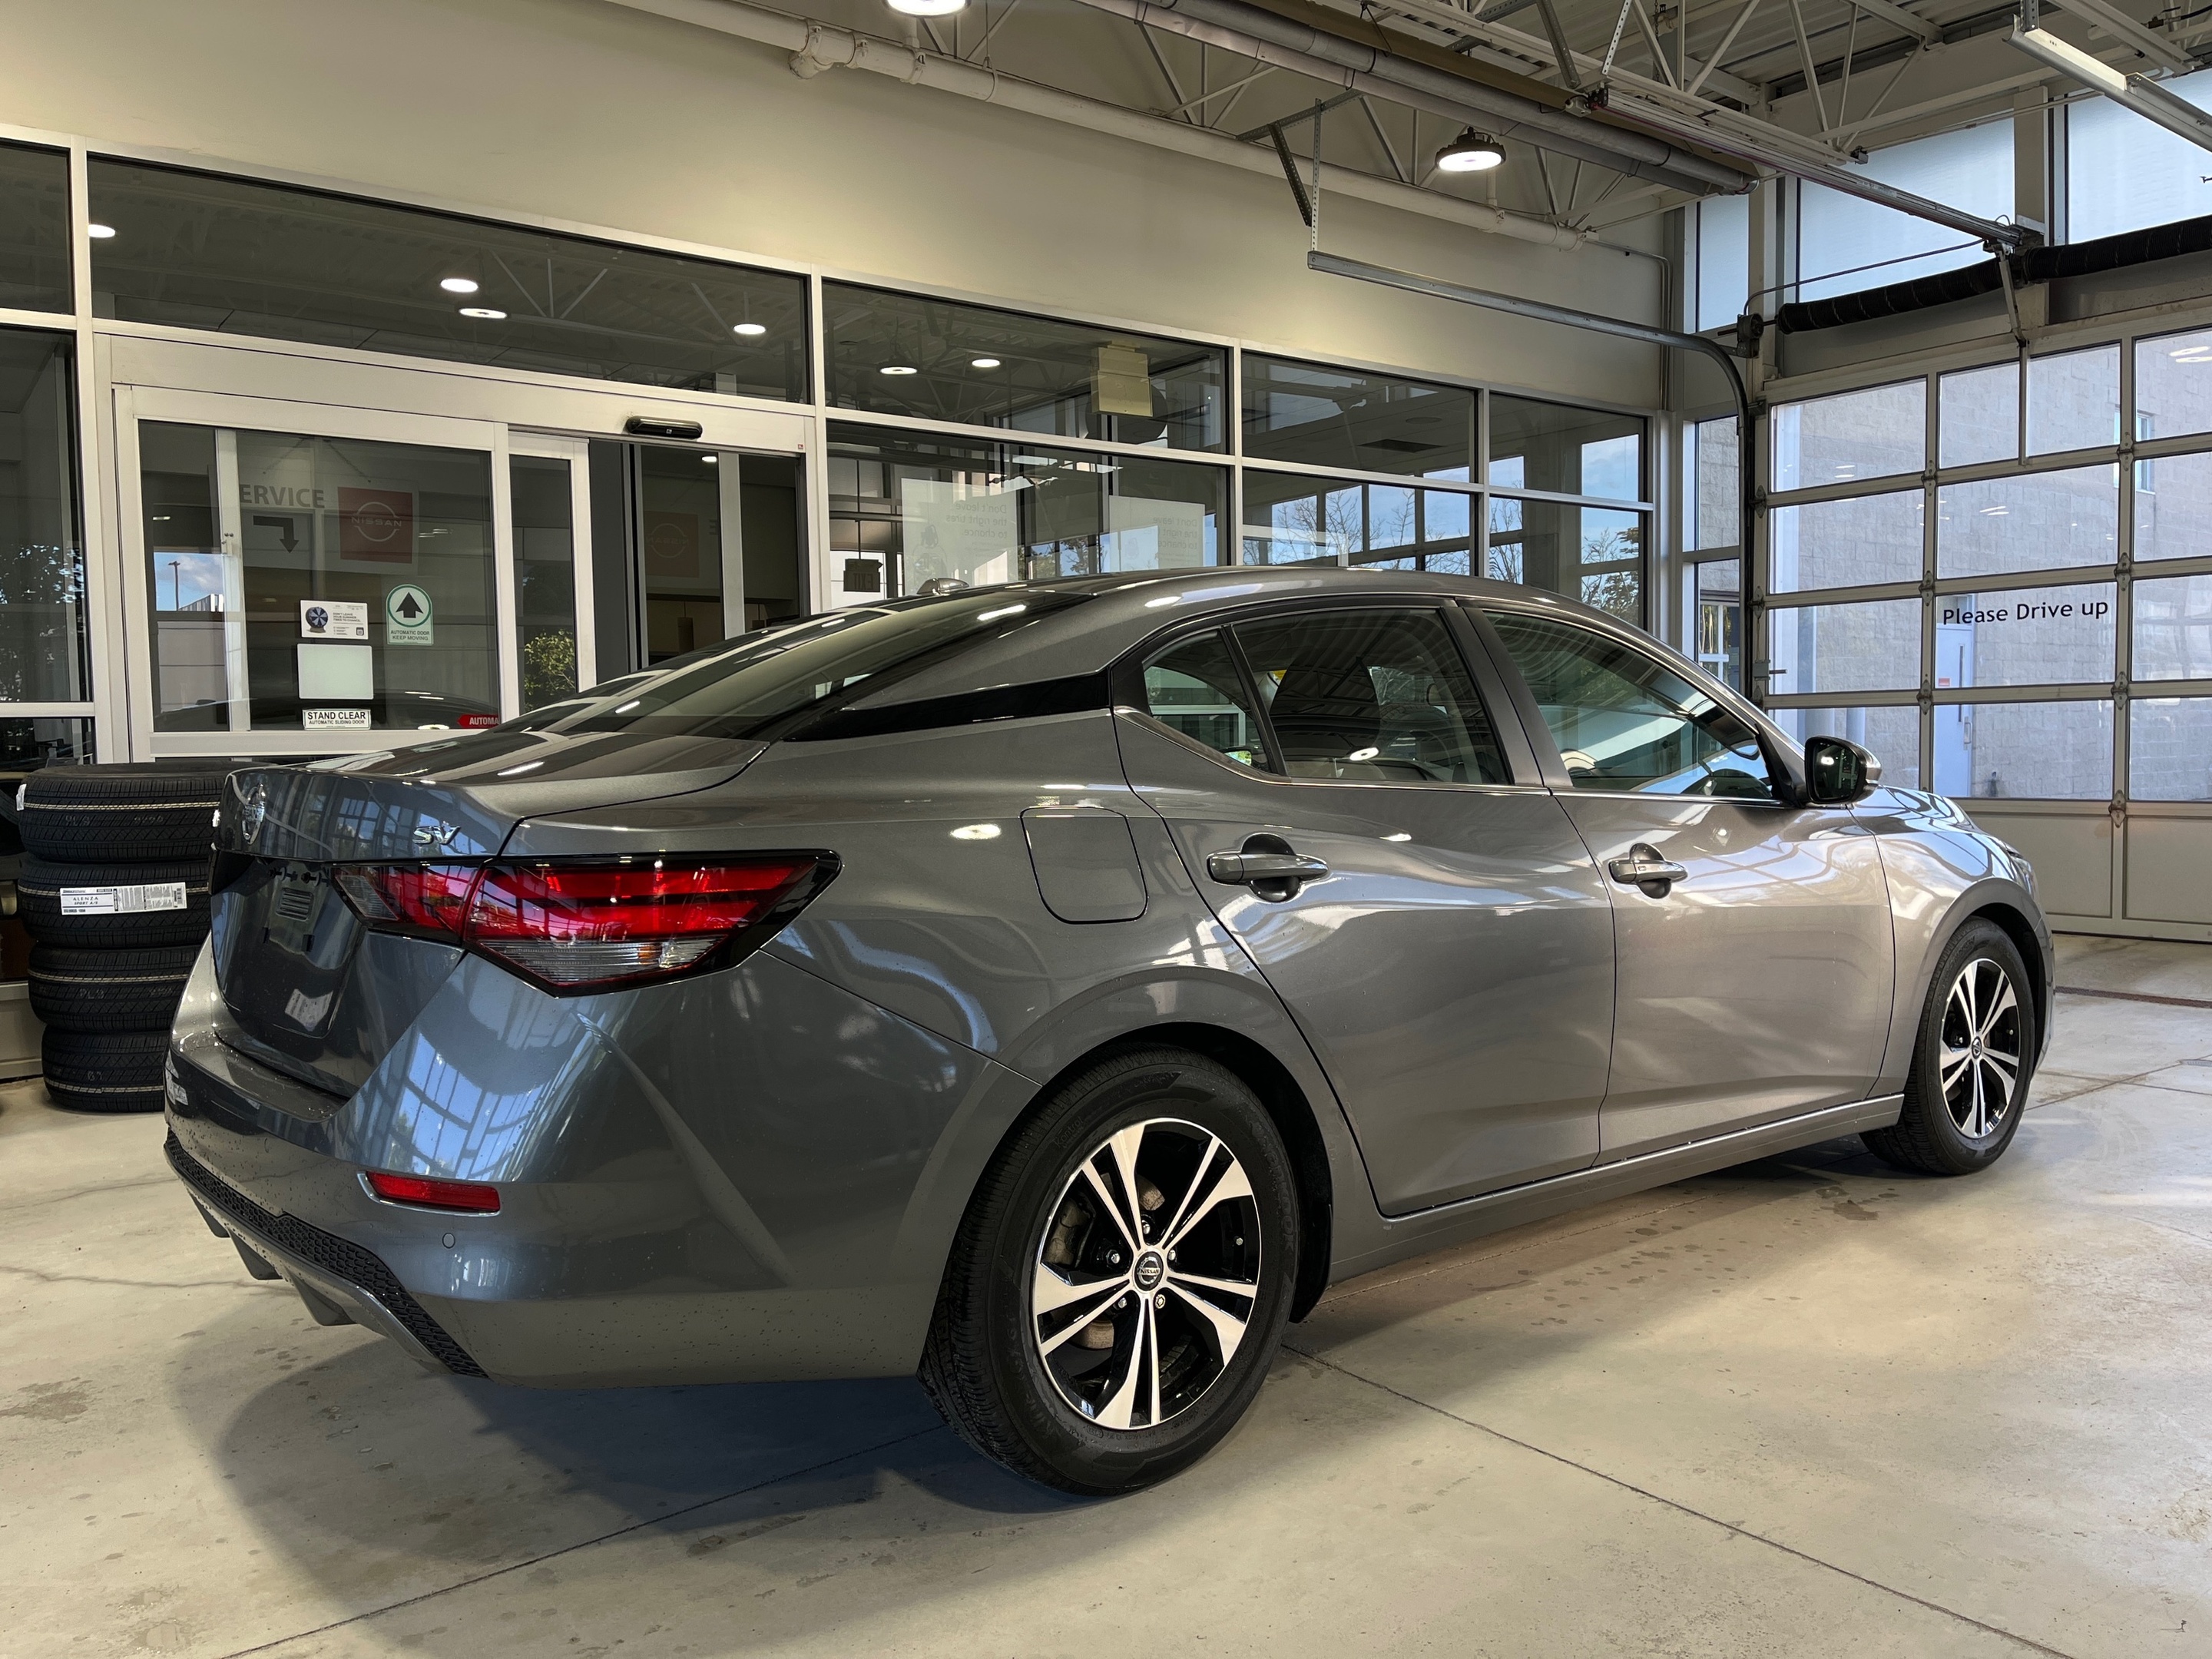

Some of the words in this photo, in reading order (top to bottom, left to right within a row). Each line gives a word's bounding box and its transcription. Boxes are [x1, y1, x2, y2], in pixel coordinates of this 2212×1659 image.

[240, 484, 325, 508] ERVICE
[351, 516, 402, 527] NISSAN
[1943, 608, 2008, 625] Please
[2016, 601, 2073, 620] Drive
[2081, 601, 2108, 620] up
[307, 711, 336, 720] STAND
[338, 711, 366, 720] CLEAR
[469, 717, 500, 725] AUTOMA
[412, 825, 461, 845] SV
